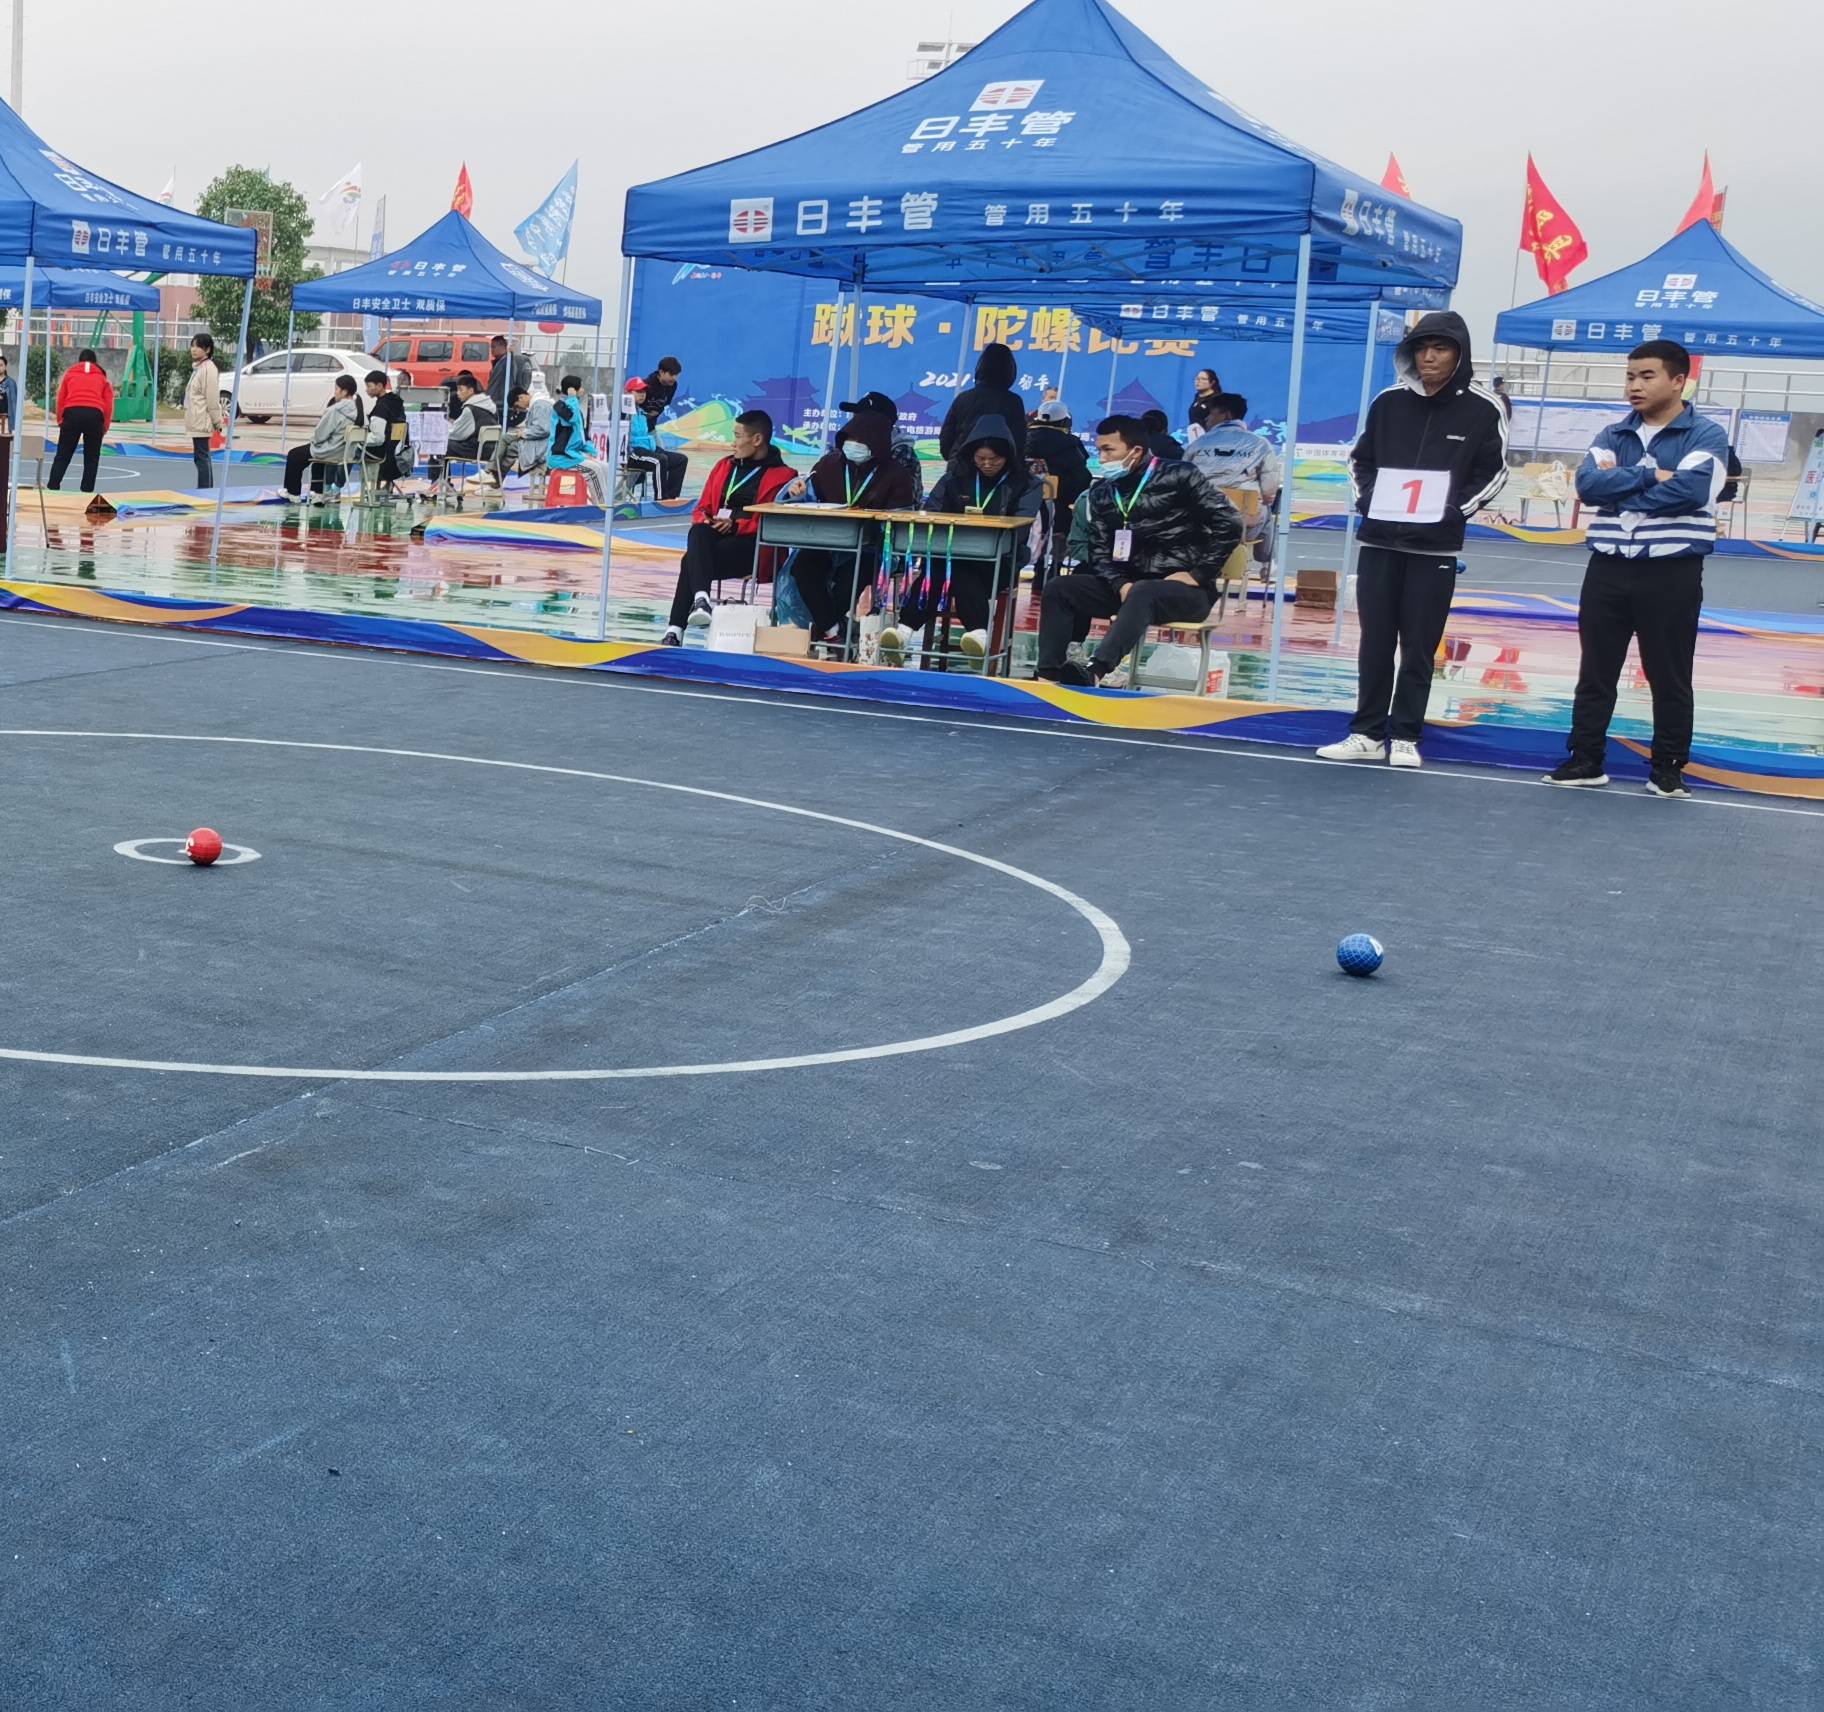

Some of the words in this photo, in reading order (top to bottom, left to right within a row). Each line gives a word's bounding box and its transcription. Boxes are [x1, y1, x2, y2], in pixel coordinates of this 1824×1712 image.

[910, 110, 1076, 140] 日丰管
[901, 137, 1058, 153] 管用五十年
[796, 191, 939, 237] 日丰管
[984, 200, 1185, 227] 管用五十年
[97, 227, 149, 257] 日丰管
[162, 243, 222, 266] 管用五十年
[352, 298, 412, 311] 日丰安全卫士
[1636, 289, 1719, 303] 日丰管
[1151, 305, 1220, 322] 日丰管
[1237, 313, 1325, 331] 管用五年
[1587, 323, 1663, 342] 日丰管
[1683, 332, 1784, 348] 管用五十年
[1402, 479, 1423, 514] 1
